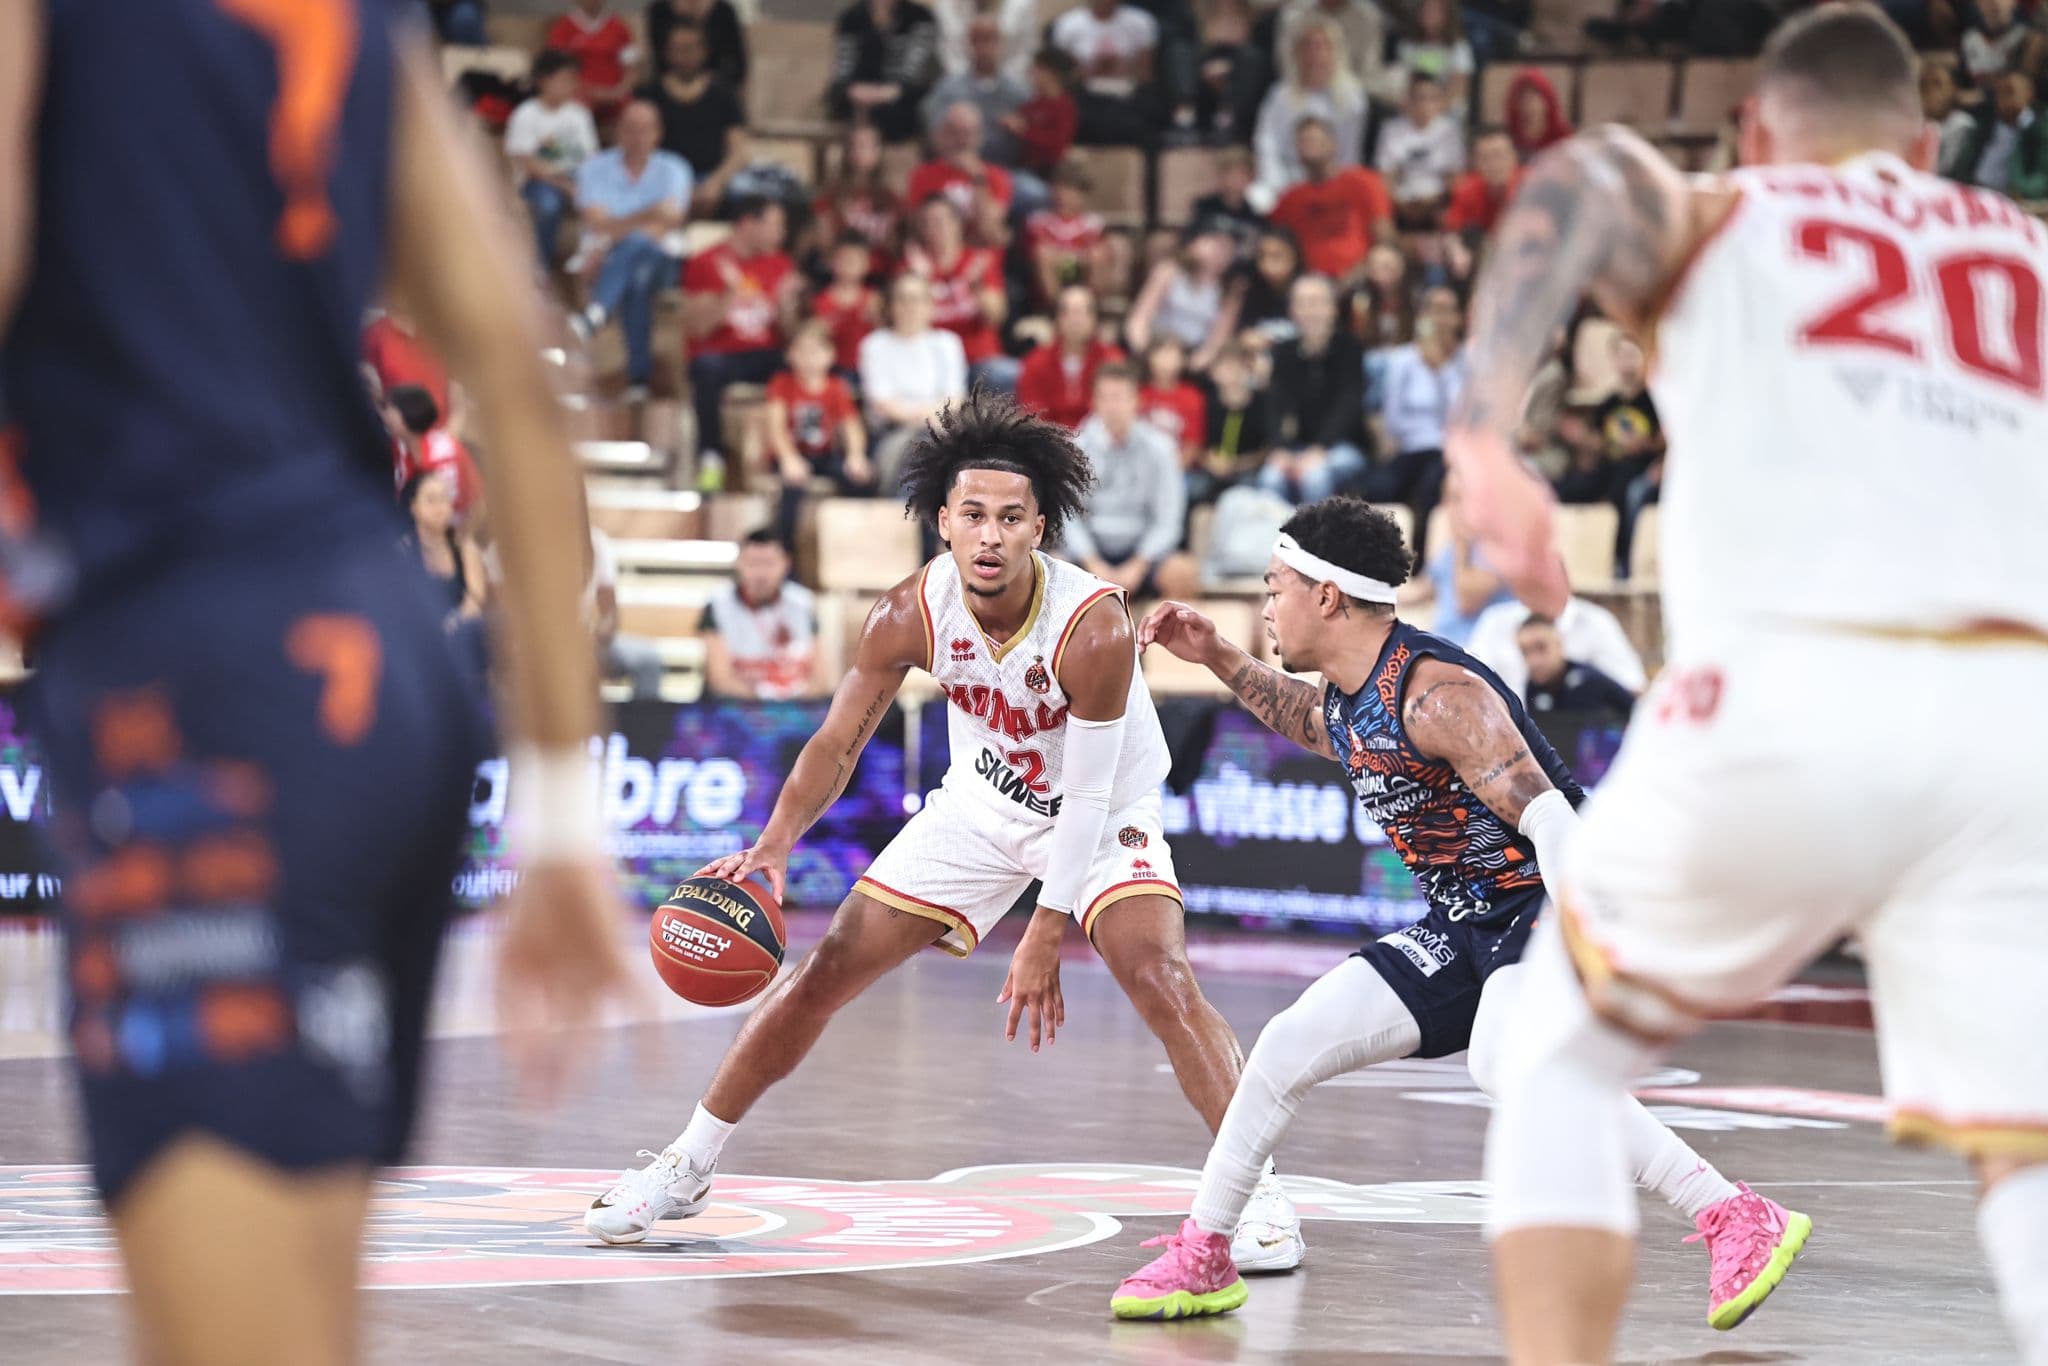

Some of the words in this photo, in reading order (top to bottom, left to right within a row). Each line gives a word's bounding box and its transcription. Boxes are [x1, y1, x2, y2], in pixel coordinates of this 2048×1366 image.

[1786, 215, 2047, 400] 20
[975, 747, 1064, 818] SKWEE
[668, 884, 755, 930] SPALDING
[661, 914, 732, 952] LEGACY
[674, 937, 720, 959] 1000
